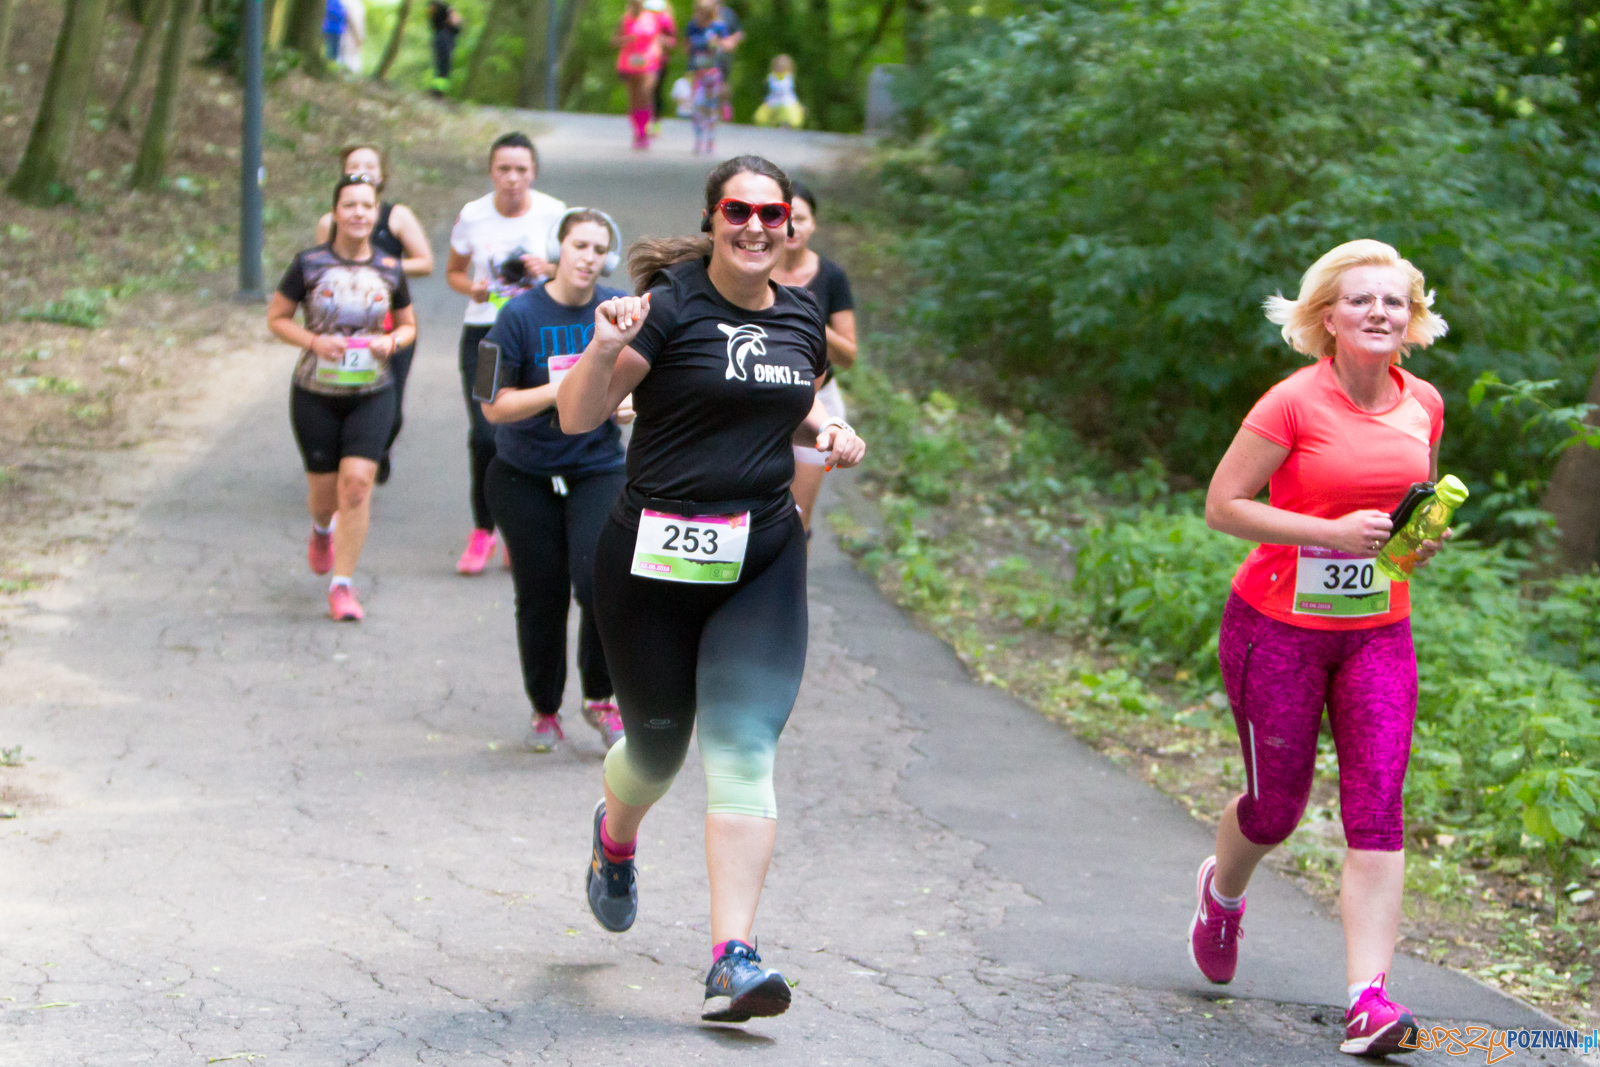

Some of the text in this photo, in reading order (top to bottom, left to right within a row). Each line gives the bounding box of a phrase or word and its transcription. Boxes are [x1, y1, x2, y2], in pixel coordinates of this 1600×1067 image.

[754, 363, 791, 385] ORKI
[662, 525, 718, 555] 253
[1323, 563, 1374, 590] 320
